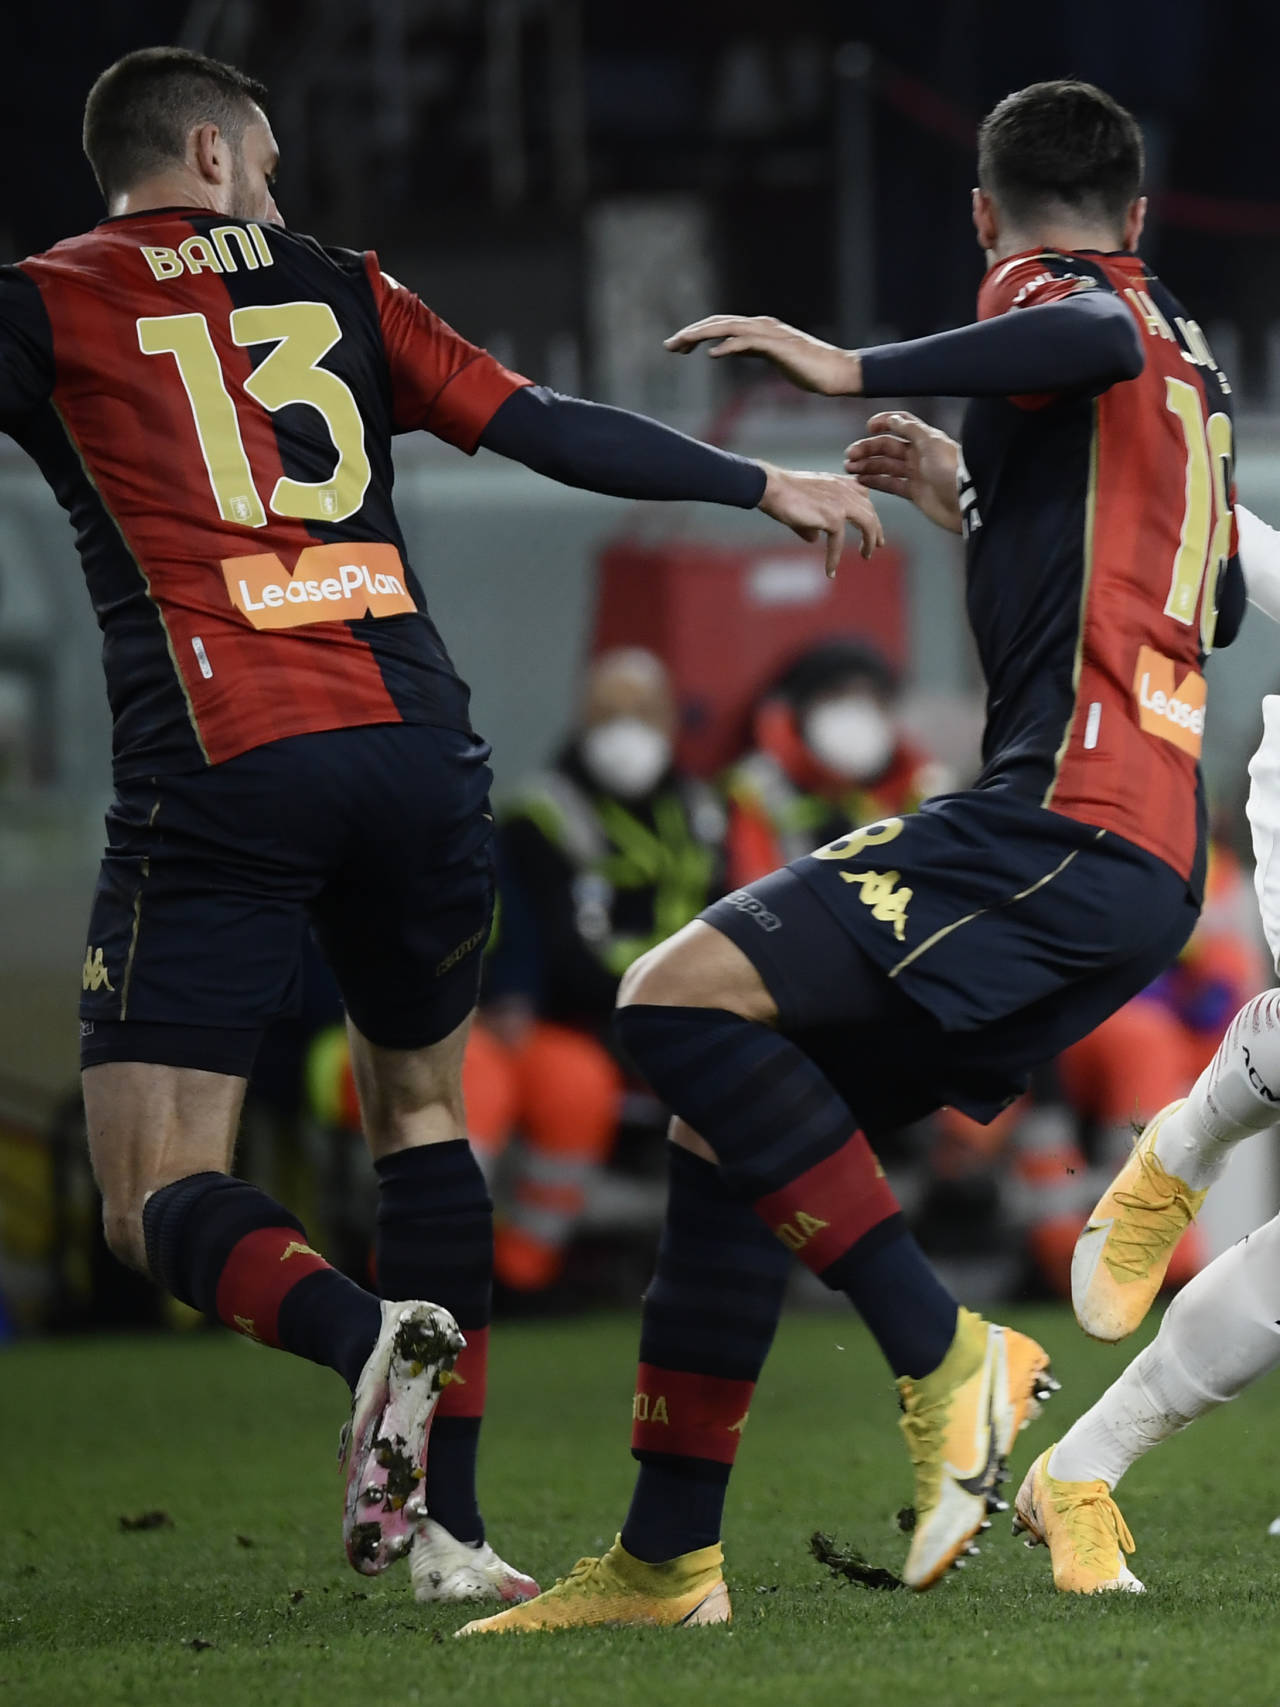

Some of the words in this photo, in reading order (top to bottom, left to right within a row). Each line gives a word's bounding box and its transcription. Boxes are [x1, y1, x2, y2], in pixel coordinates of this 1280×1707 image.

[139, 223, 274, 281] BANI
[136, 301, 372, 528] 13
[238, 564, 406, 612] LeasePlan
[1140, 672, 1206, 736] Lease
